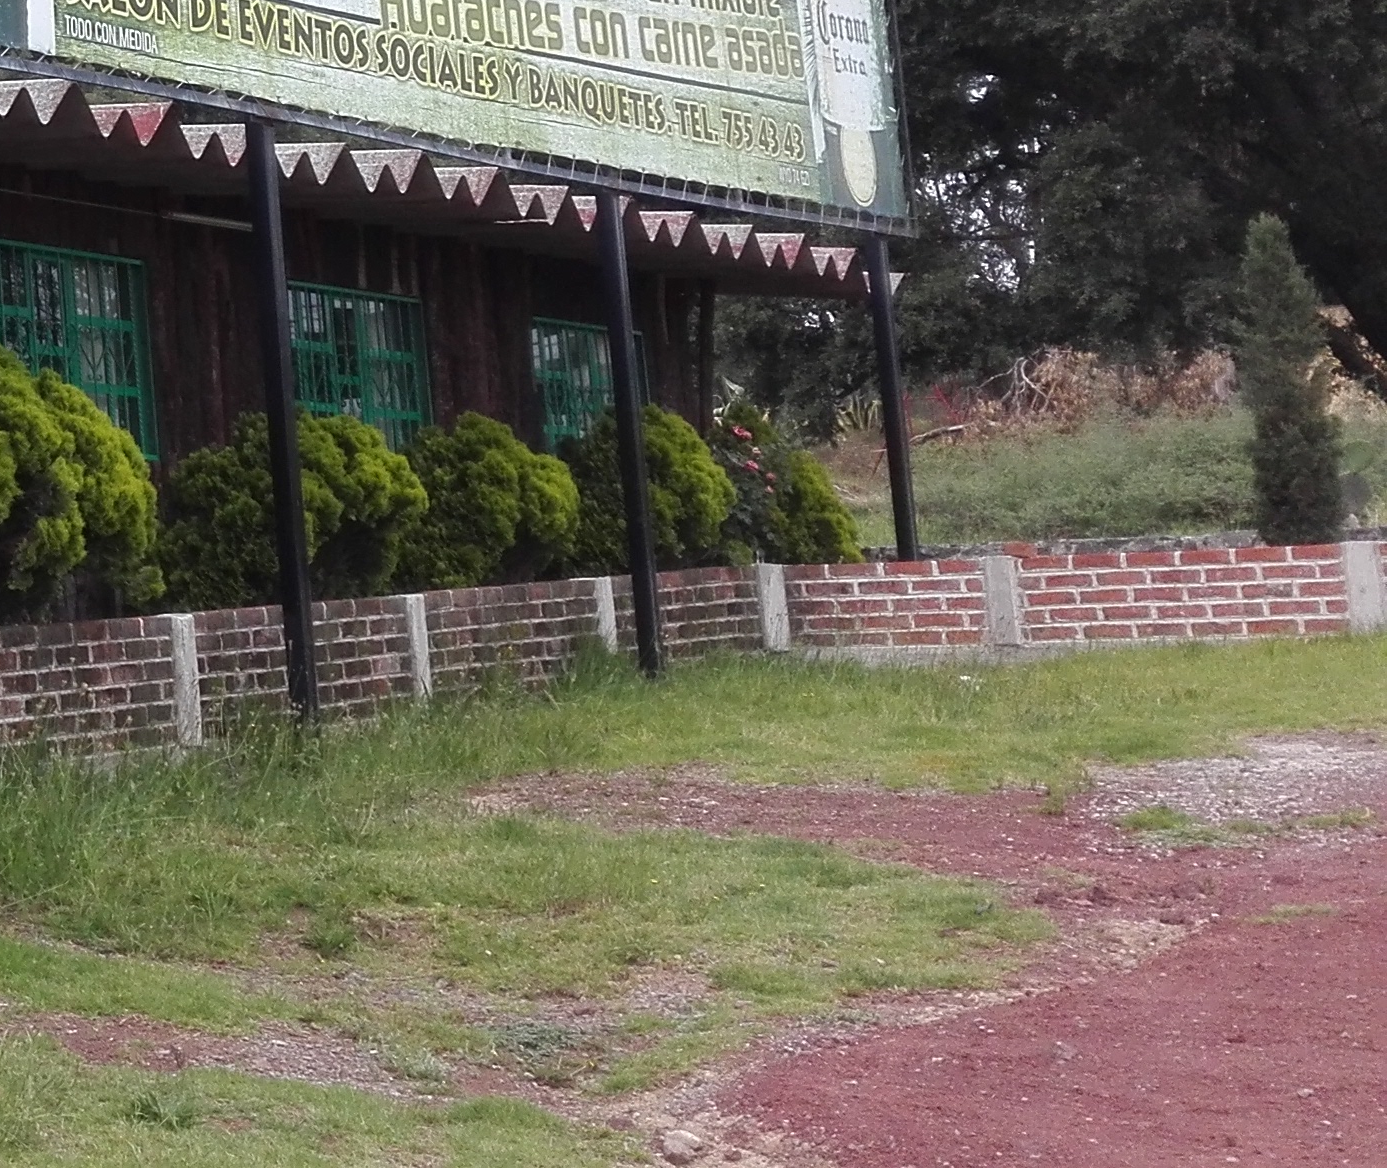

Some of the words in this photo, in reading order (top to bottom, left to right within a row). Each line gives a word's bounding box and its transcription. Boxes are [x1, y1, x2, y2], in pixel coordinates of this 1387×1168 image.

[64, 14, 92, 40] TODO
[94, 21, 116, 46] CON
[118, 26, 159, 54] MEDIDA
[573, 4, 631, 60] con
[638, 15, 719, 69] carne
[726, 18, 806, 79] asada
[832, 48, 868, 77] Extra
[375, 33, 502, 100] SOCIALES
[503, 59, 524, 104] Y
[721, 108, 754, 151] 755
[757, 115, 781, 158] 43
[783, 122, 806, 162] 43
